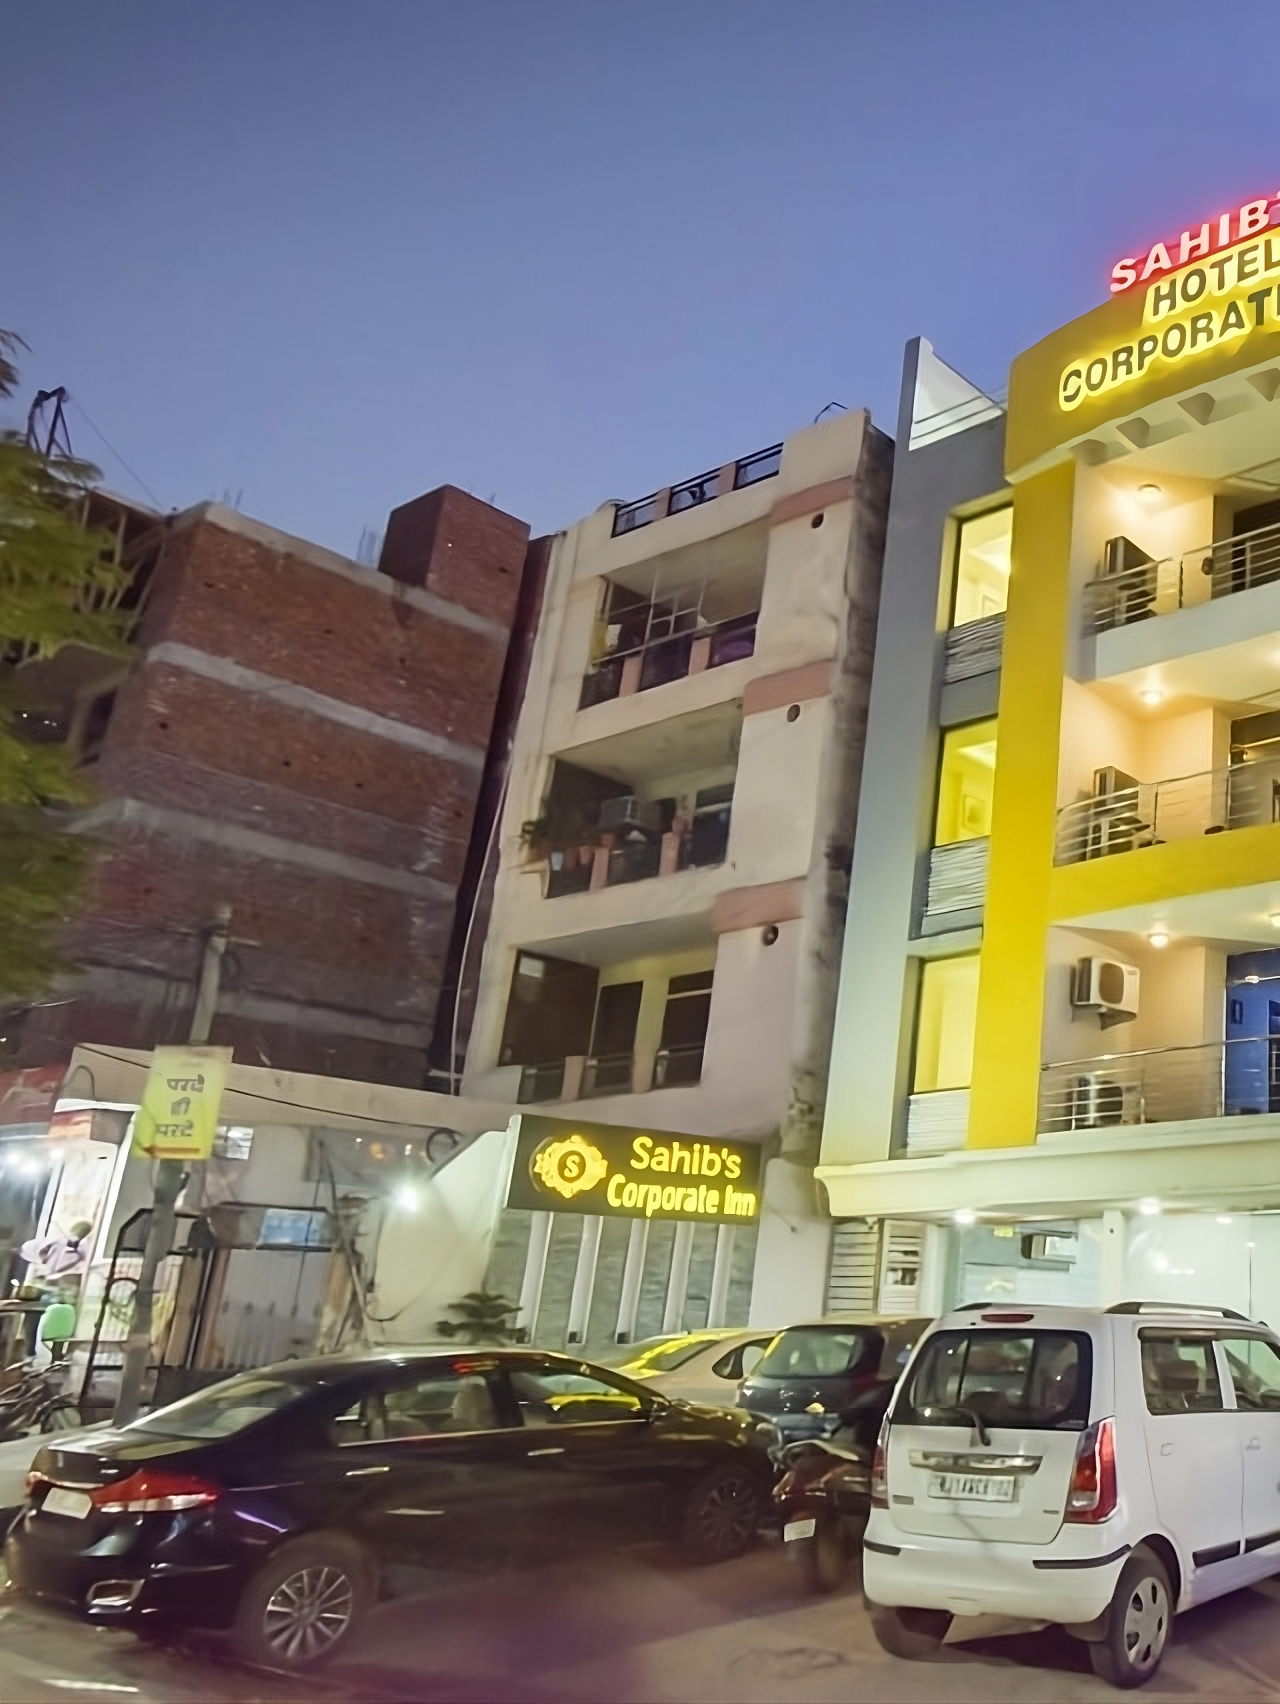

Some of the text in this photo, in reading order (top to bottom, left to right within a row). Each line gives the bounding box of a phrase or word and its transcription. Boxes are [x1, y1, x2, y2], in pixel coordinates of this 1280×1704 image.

[630, 1136, 741, 1178] Sahib's
[607, 1174, 756, 1217] Corporate Inn
